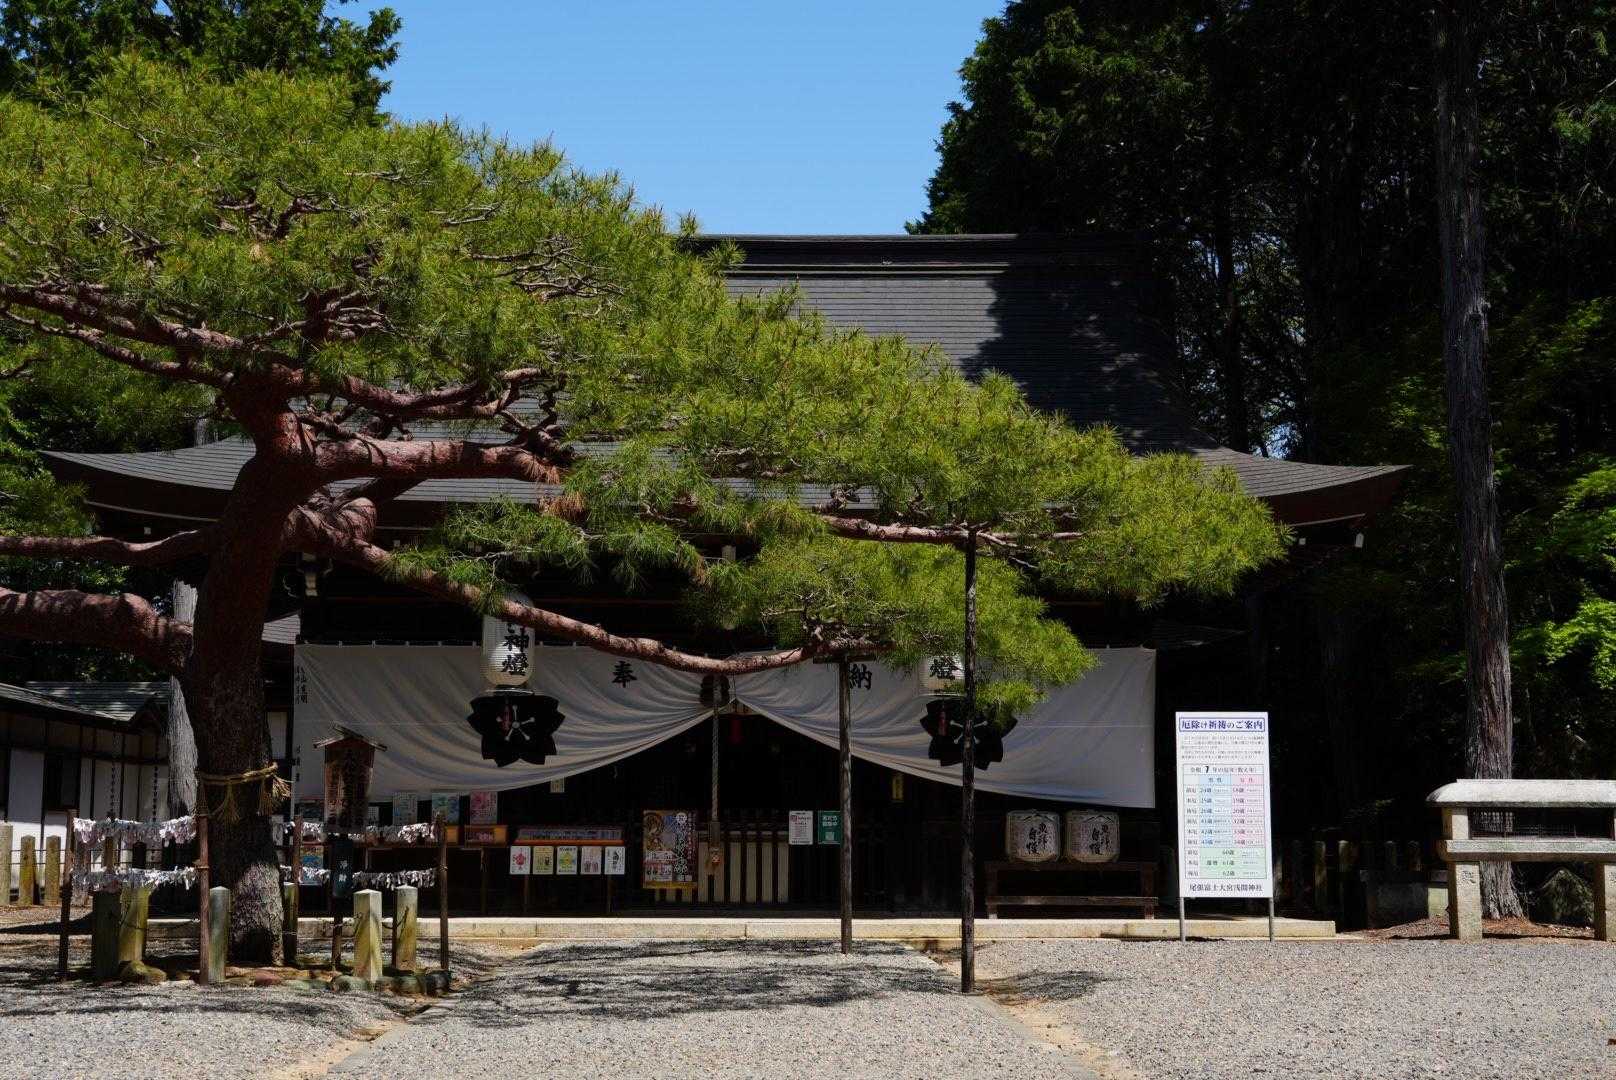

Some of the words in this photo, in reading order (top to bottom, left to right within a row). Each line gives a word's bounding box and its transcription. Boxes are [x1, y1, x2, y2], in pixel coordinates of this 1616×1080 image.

[611, 660, 638, 689] 奉
[848, 663, 873, 690] 納
[1204, 765, 1210, 774] 7
